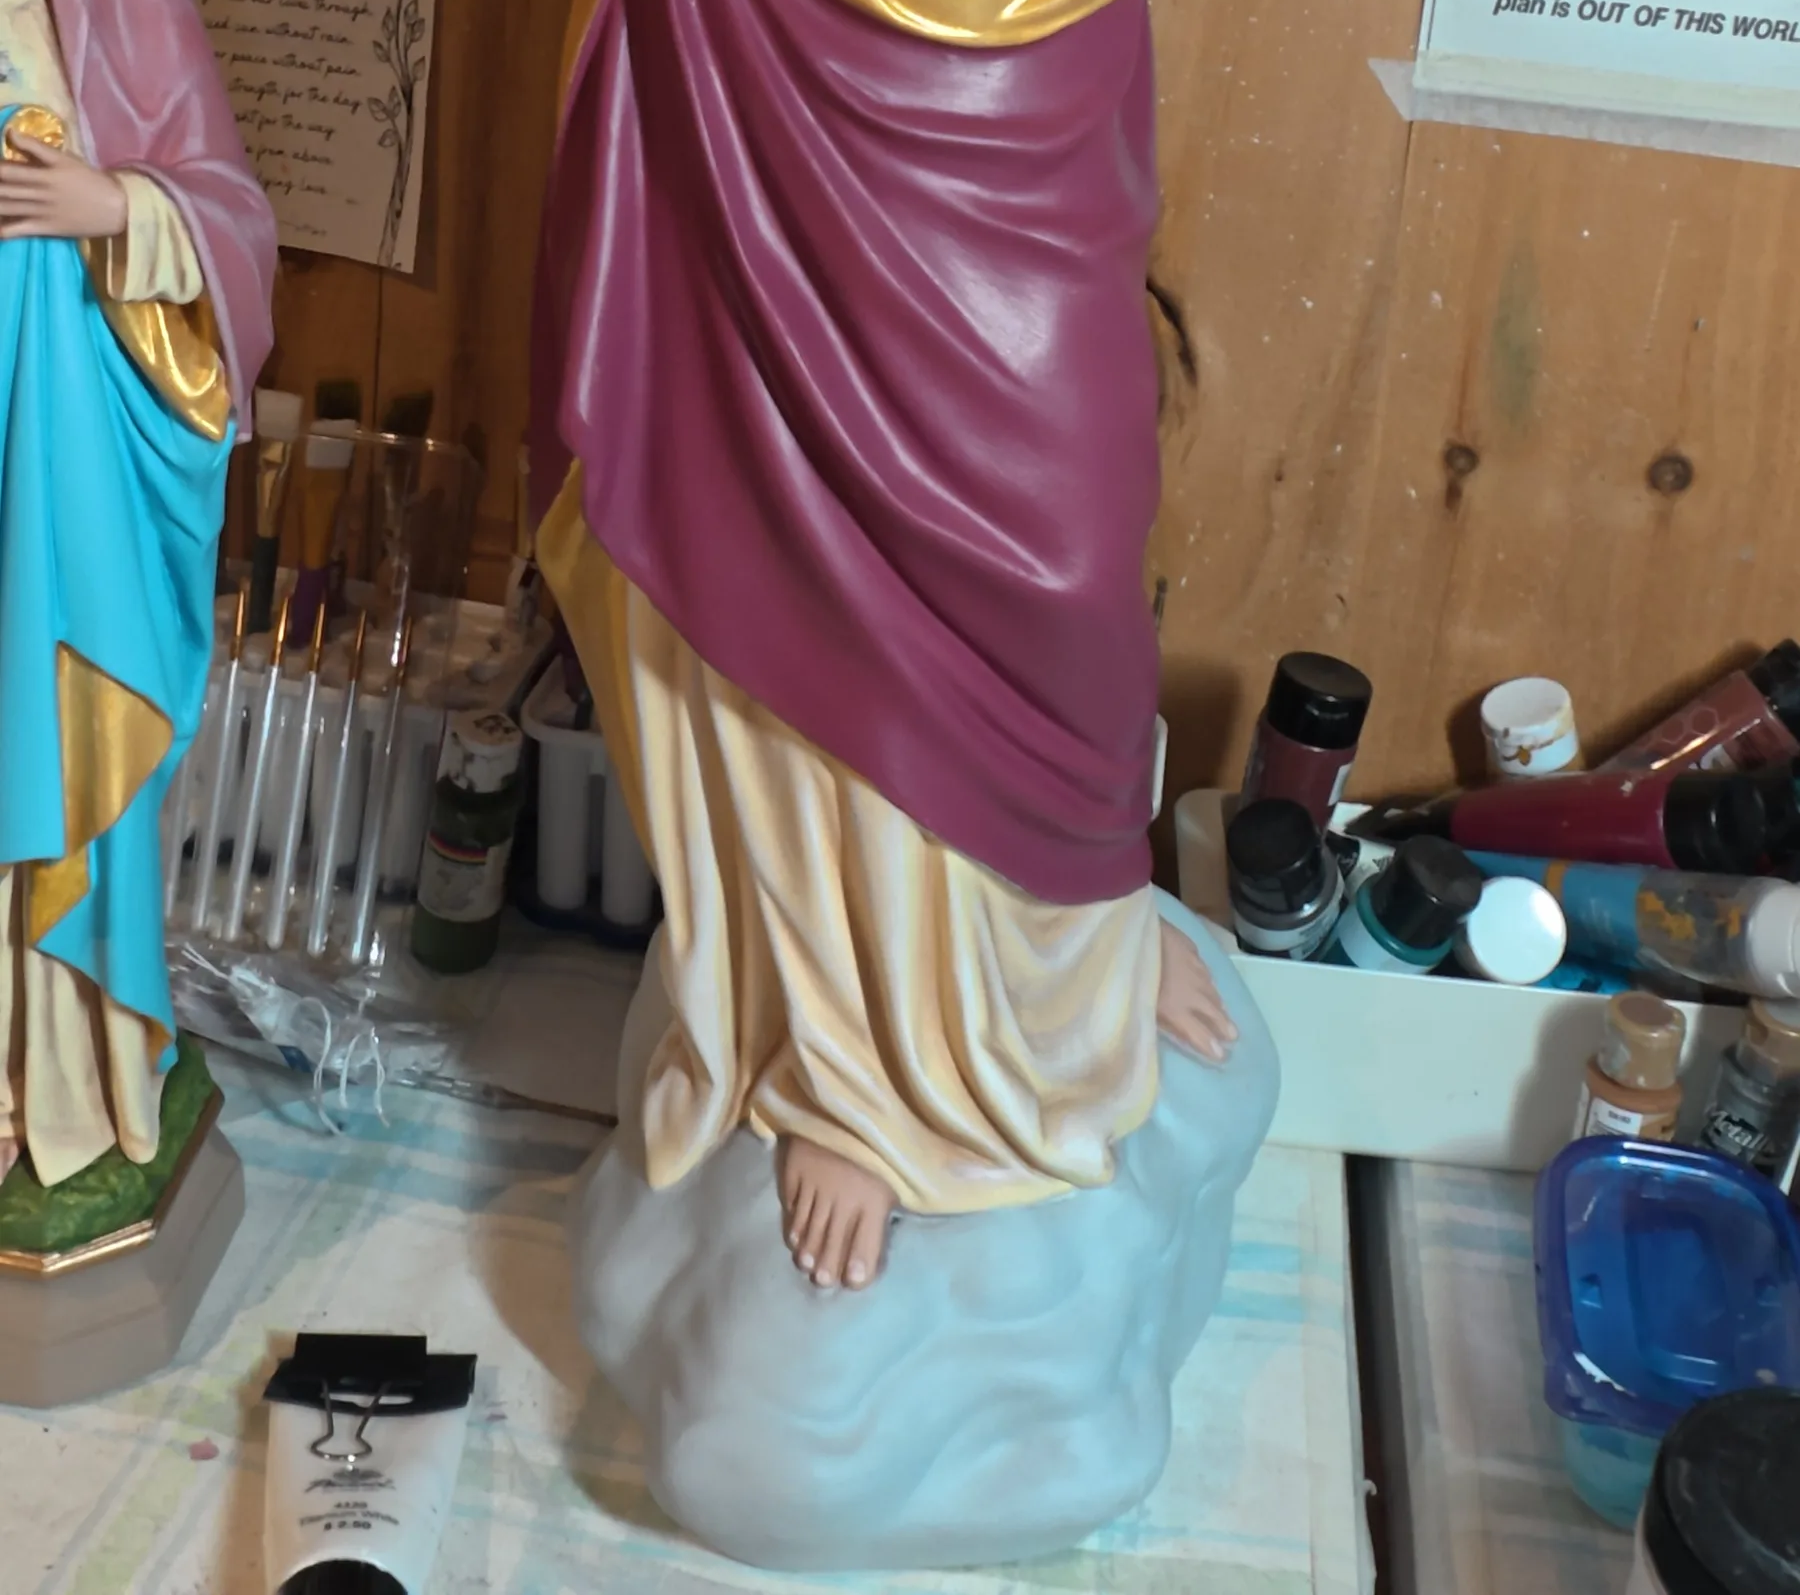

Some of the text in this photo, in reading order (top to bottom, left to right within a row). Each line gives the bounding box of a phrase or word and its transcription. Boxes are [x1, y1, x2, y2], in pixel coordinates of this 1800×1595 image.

[1633, 4, 1670, 27] OF
[1674, 8, 1727, 35] THIS
[1732, 15, 1800, 43] WORL
